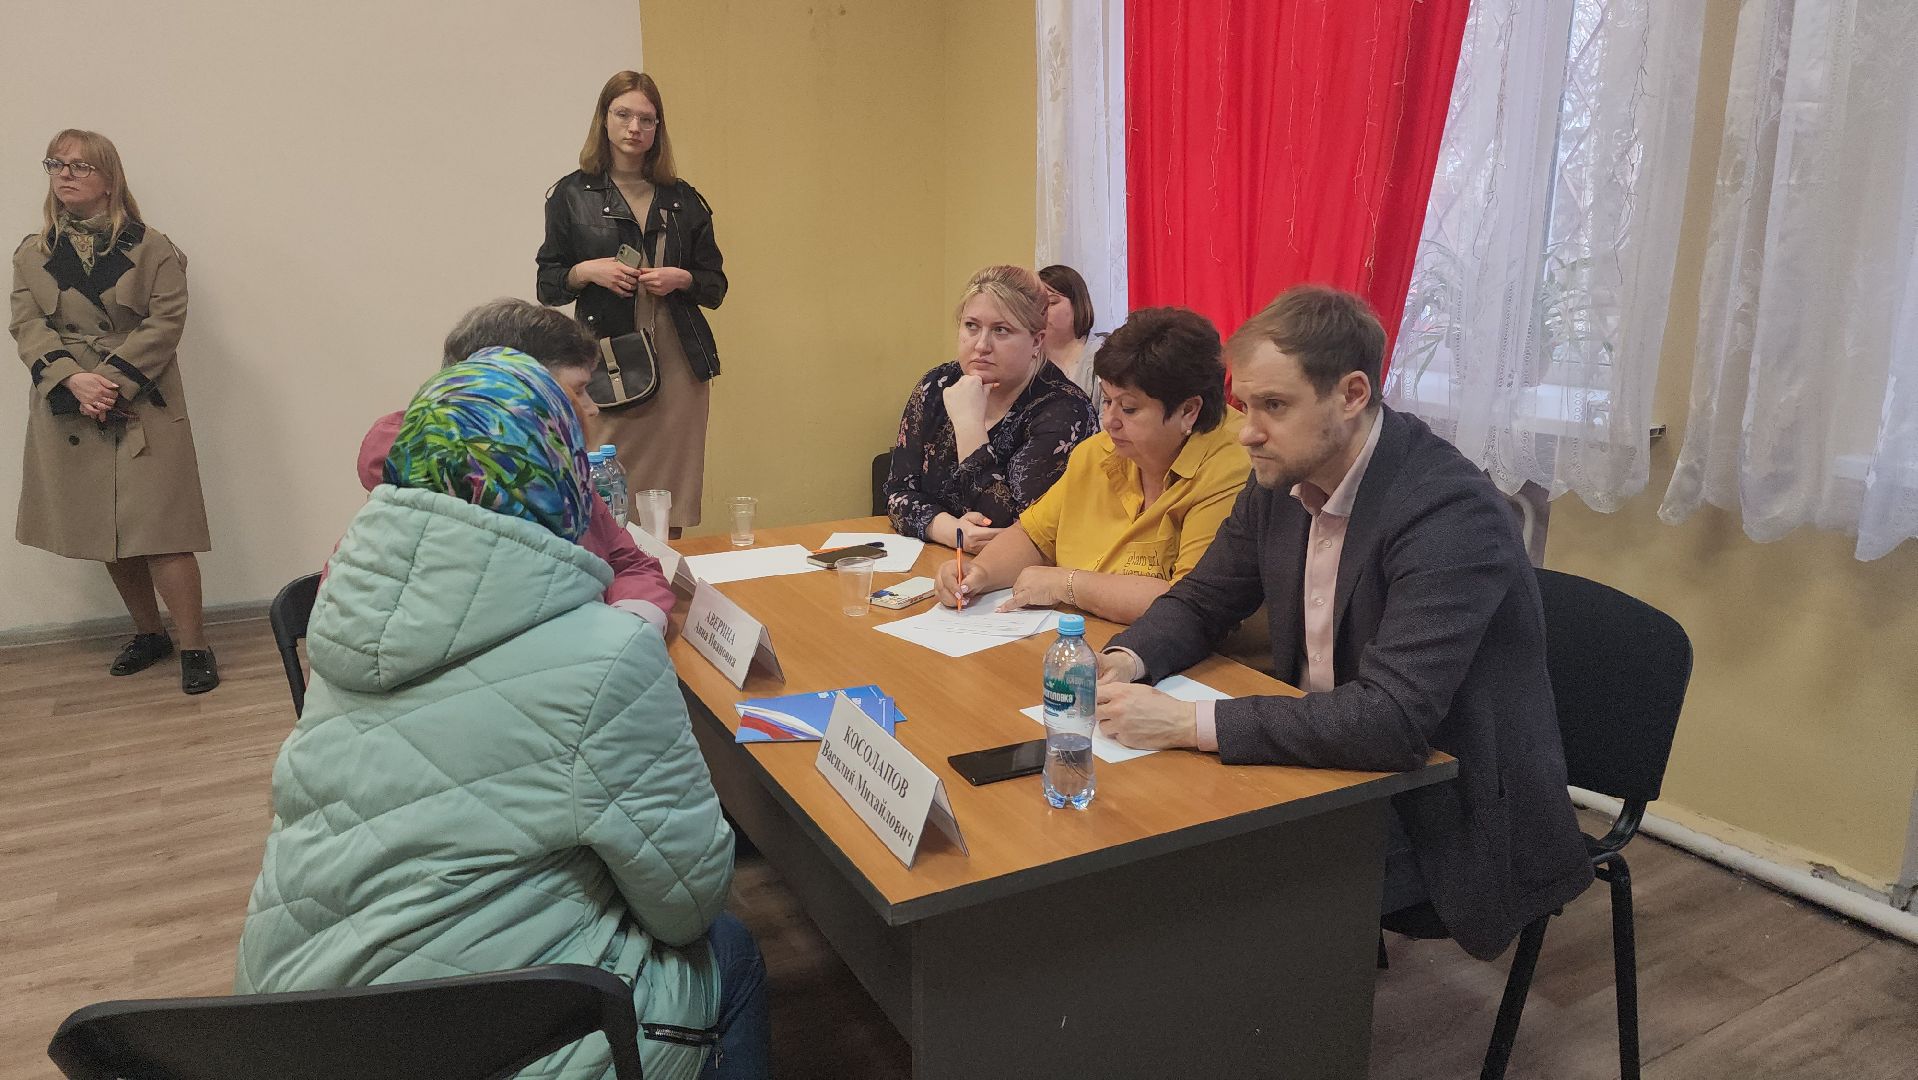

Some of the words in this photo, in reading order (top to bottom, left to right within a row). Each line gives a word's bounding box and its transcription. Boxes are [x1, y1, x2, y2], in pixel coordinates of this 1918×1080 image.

[1124, 551, 1146, 567] glam
[695, 621, 708, 641] Анна
[708, 632, 736, 668] Ивановна
[705, 611, 735, 645] АВЕРИНА
[843, 725, 909, 799] КОСОЛАПОВ
[821, 739, 856, 786] Василий
[855, 773, 914, 847] Михайлович
